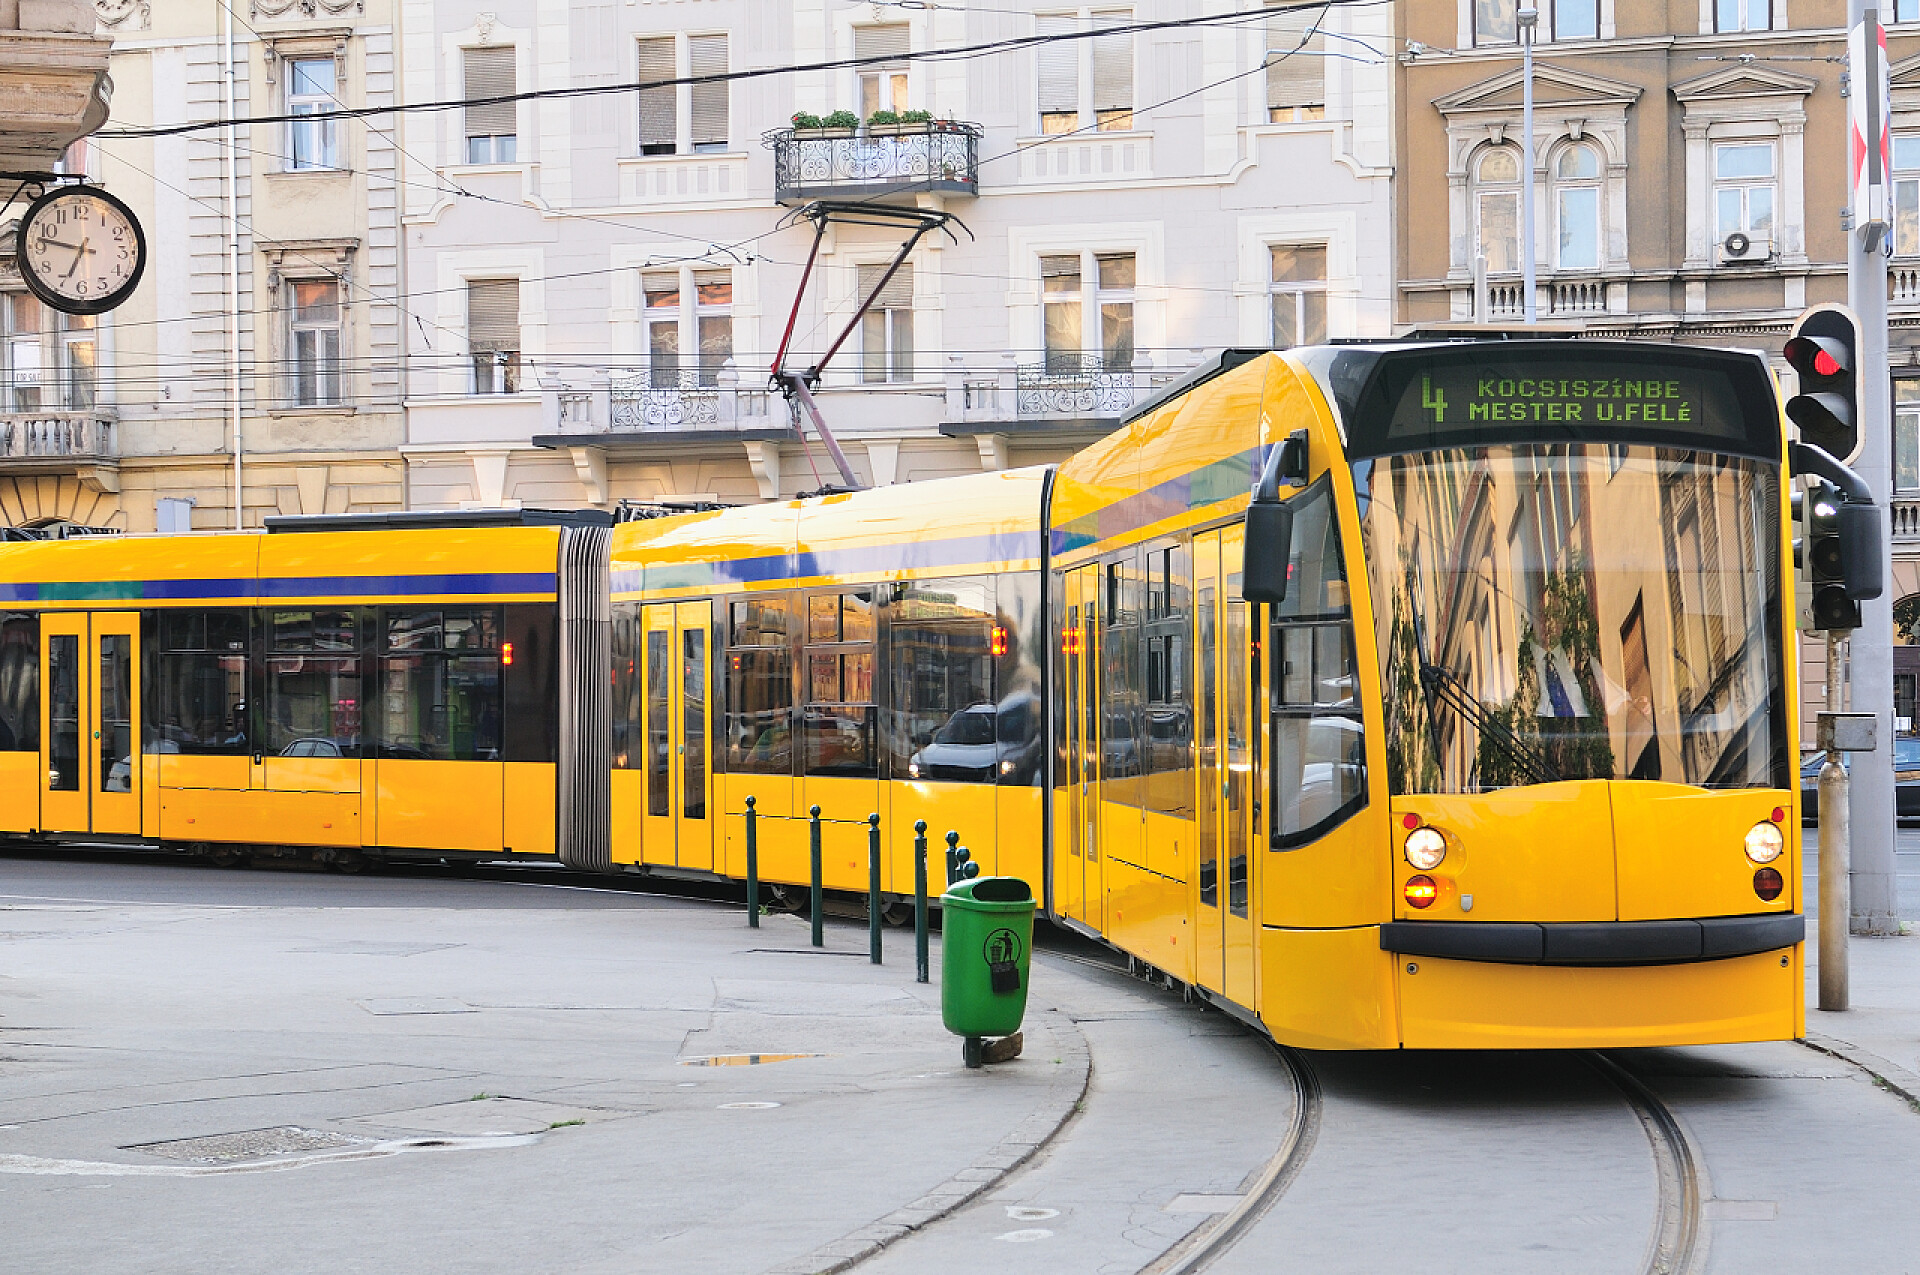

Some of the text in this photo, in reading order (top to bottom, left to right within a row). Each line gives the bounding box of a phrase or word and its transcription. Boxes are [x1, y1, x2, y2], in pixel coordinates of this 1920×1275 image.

[56, 209, 67, 225] 11
[73, 205, 89, 221] 12
[101, 212, 106, 227] 1
[41, 223, 58, 238] 10
[112, 226, 124, 241] 2
[35, 239, 47, 255] 9
[117, 245, 128, 260] 3
[41, 261, 52, 274] 8
[111, 263, 122, 277] 4
[58, 274, 70, 288] 7
[76, 281, 88, 295] 6
[97, 277, 108, 290] 5
[1422, 377, 1449, 423] 4
[1469, 401, 1692, 421] MESTER U.FELÉ
